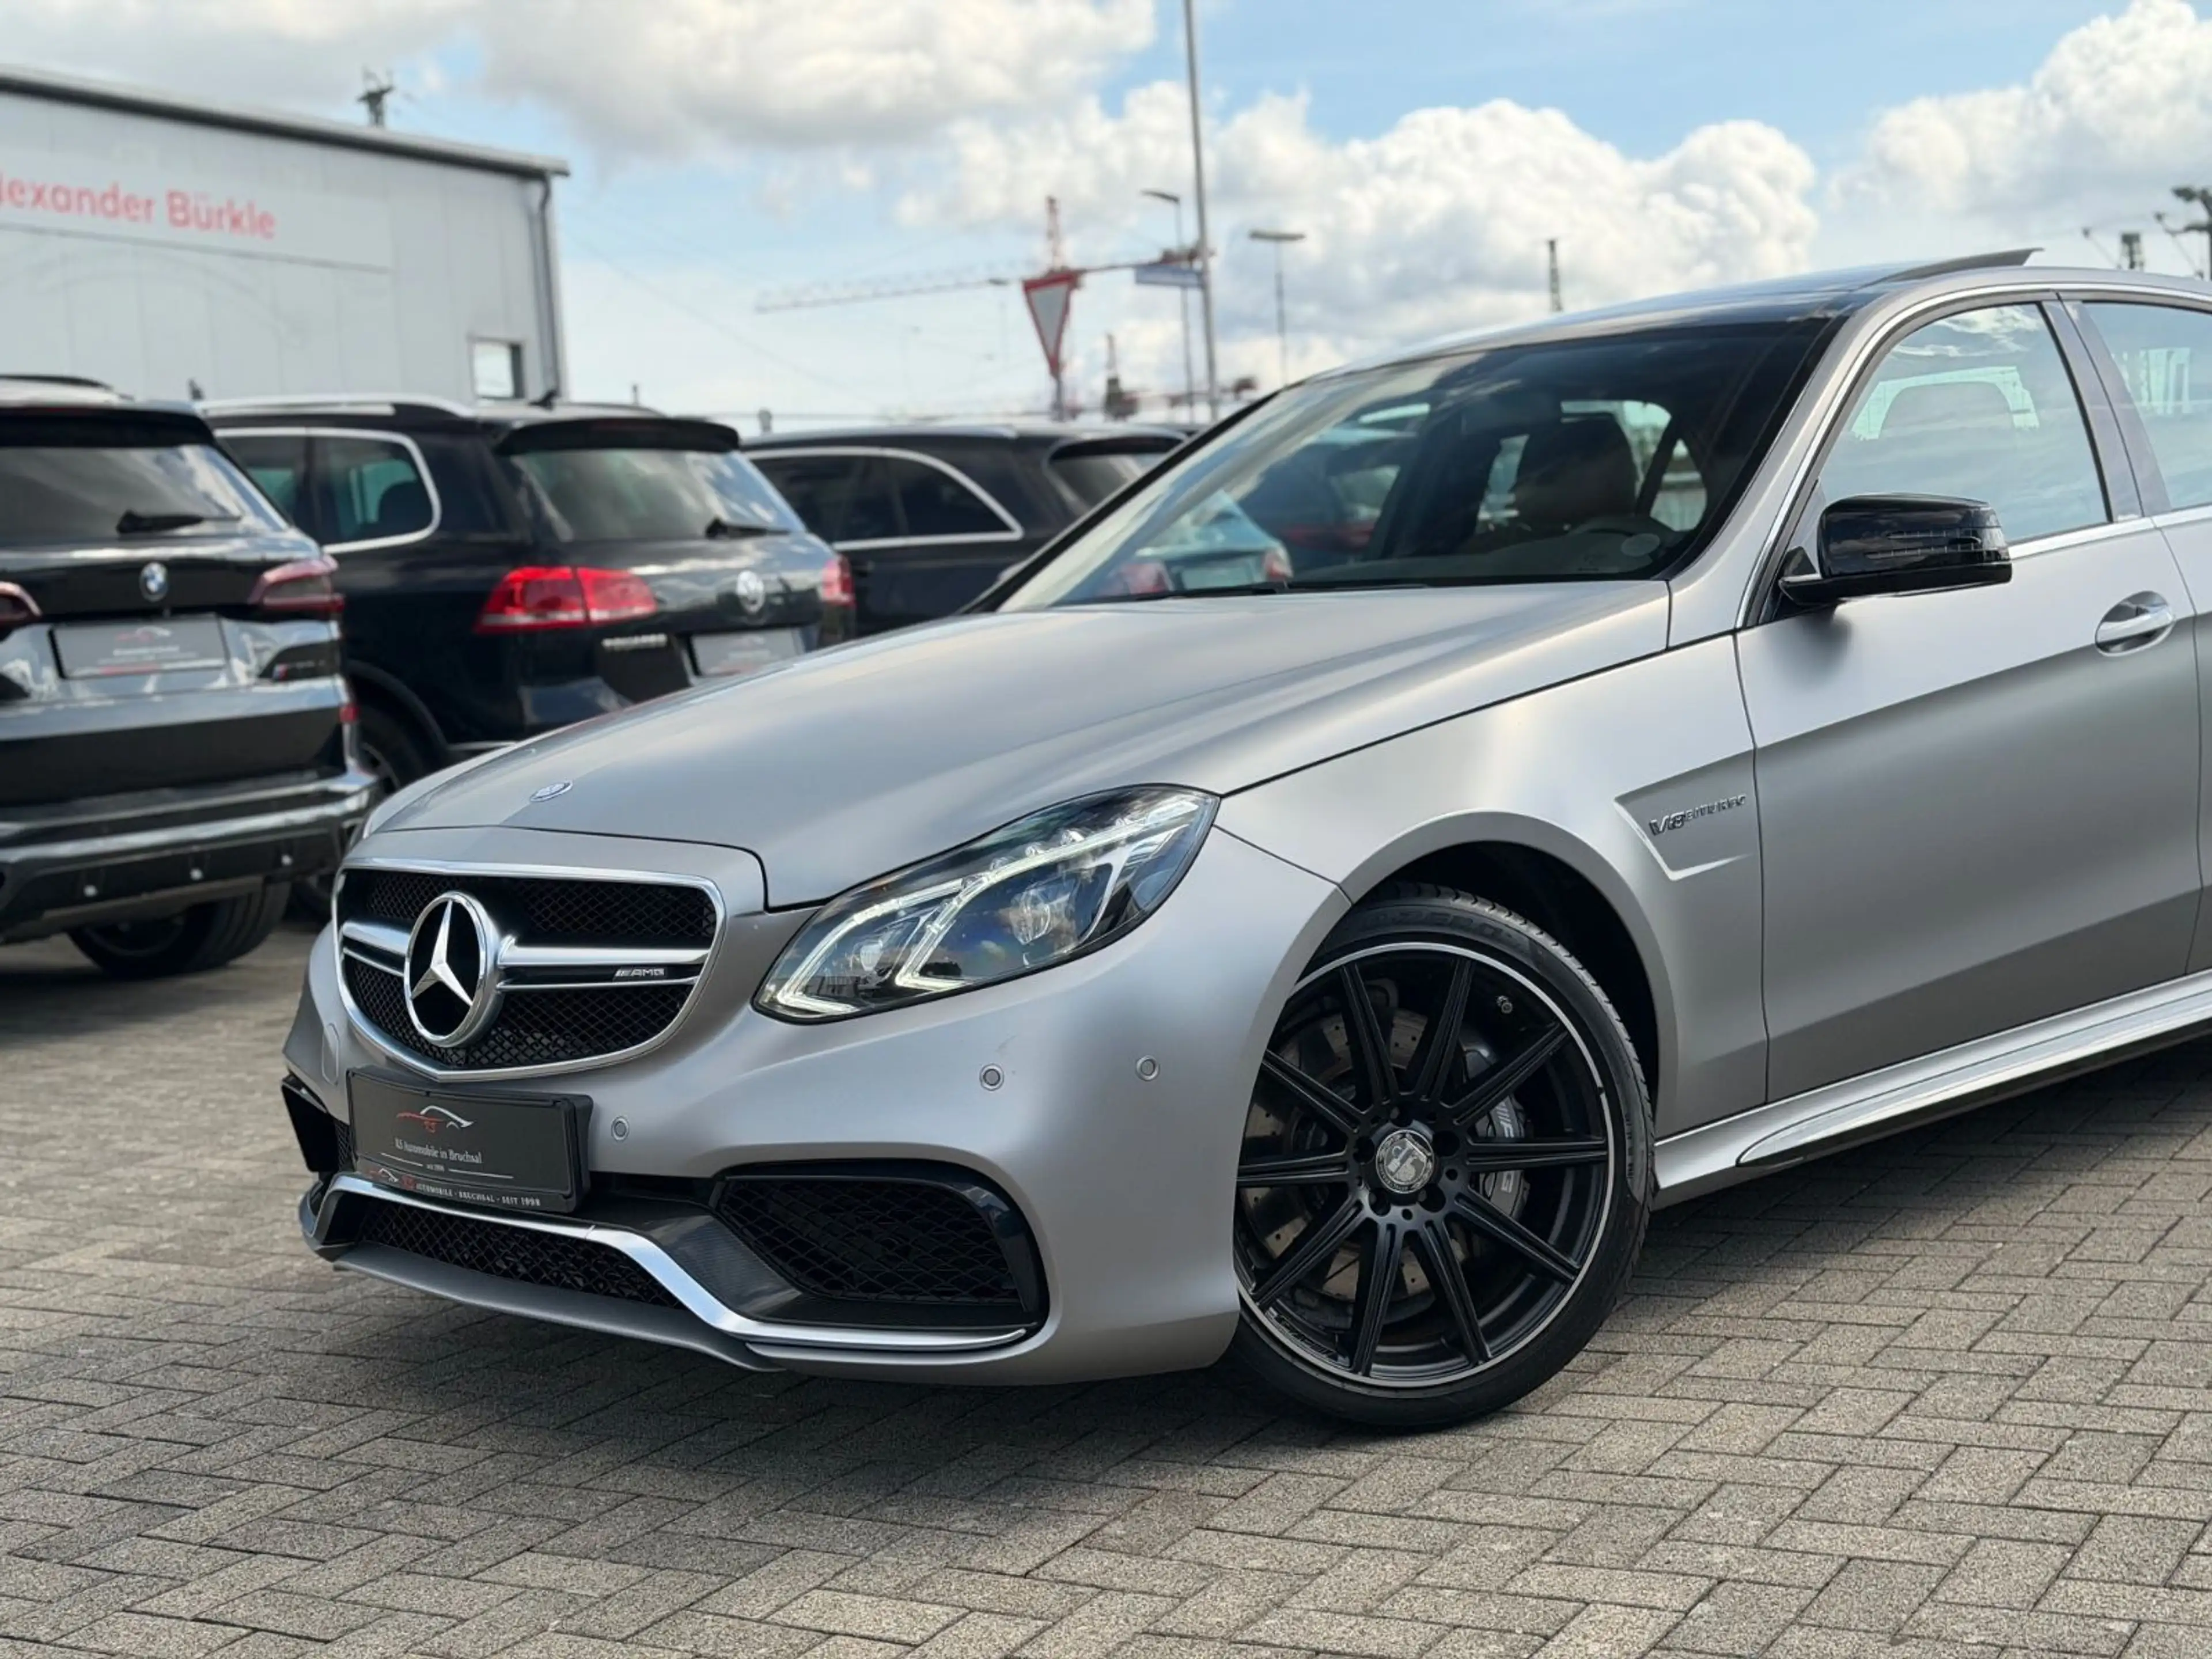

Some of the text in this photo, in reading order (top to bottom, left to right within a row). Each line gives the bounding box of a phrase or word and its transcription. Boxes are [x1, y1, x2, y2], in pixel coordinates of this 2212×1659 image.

[166, 190, 275, 239] Bürkle
[1649, 812, 1685, 835] V8
[630, 968, 665, 977] AMG
